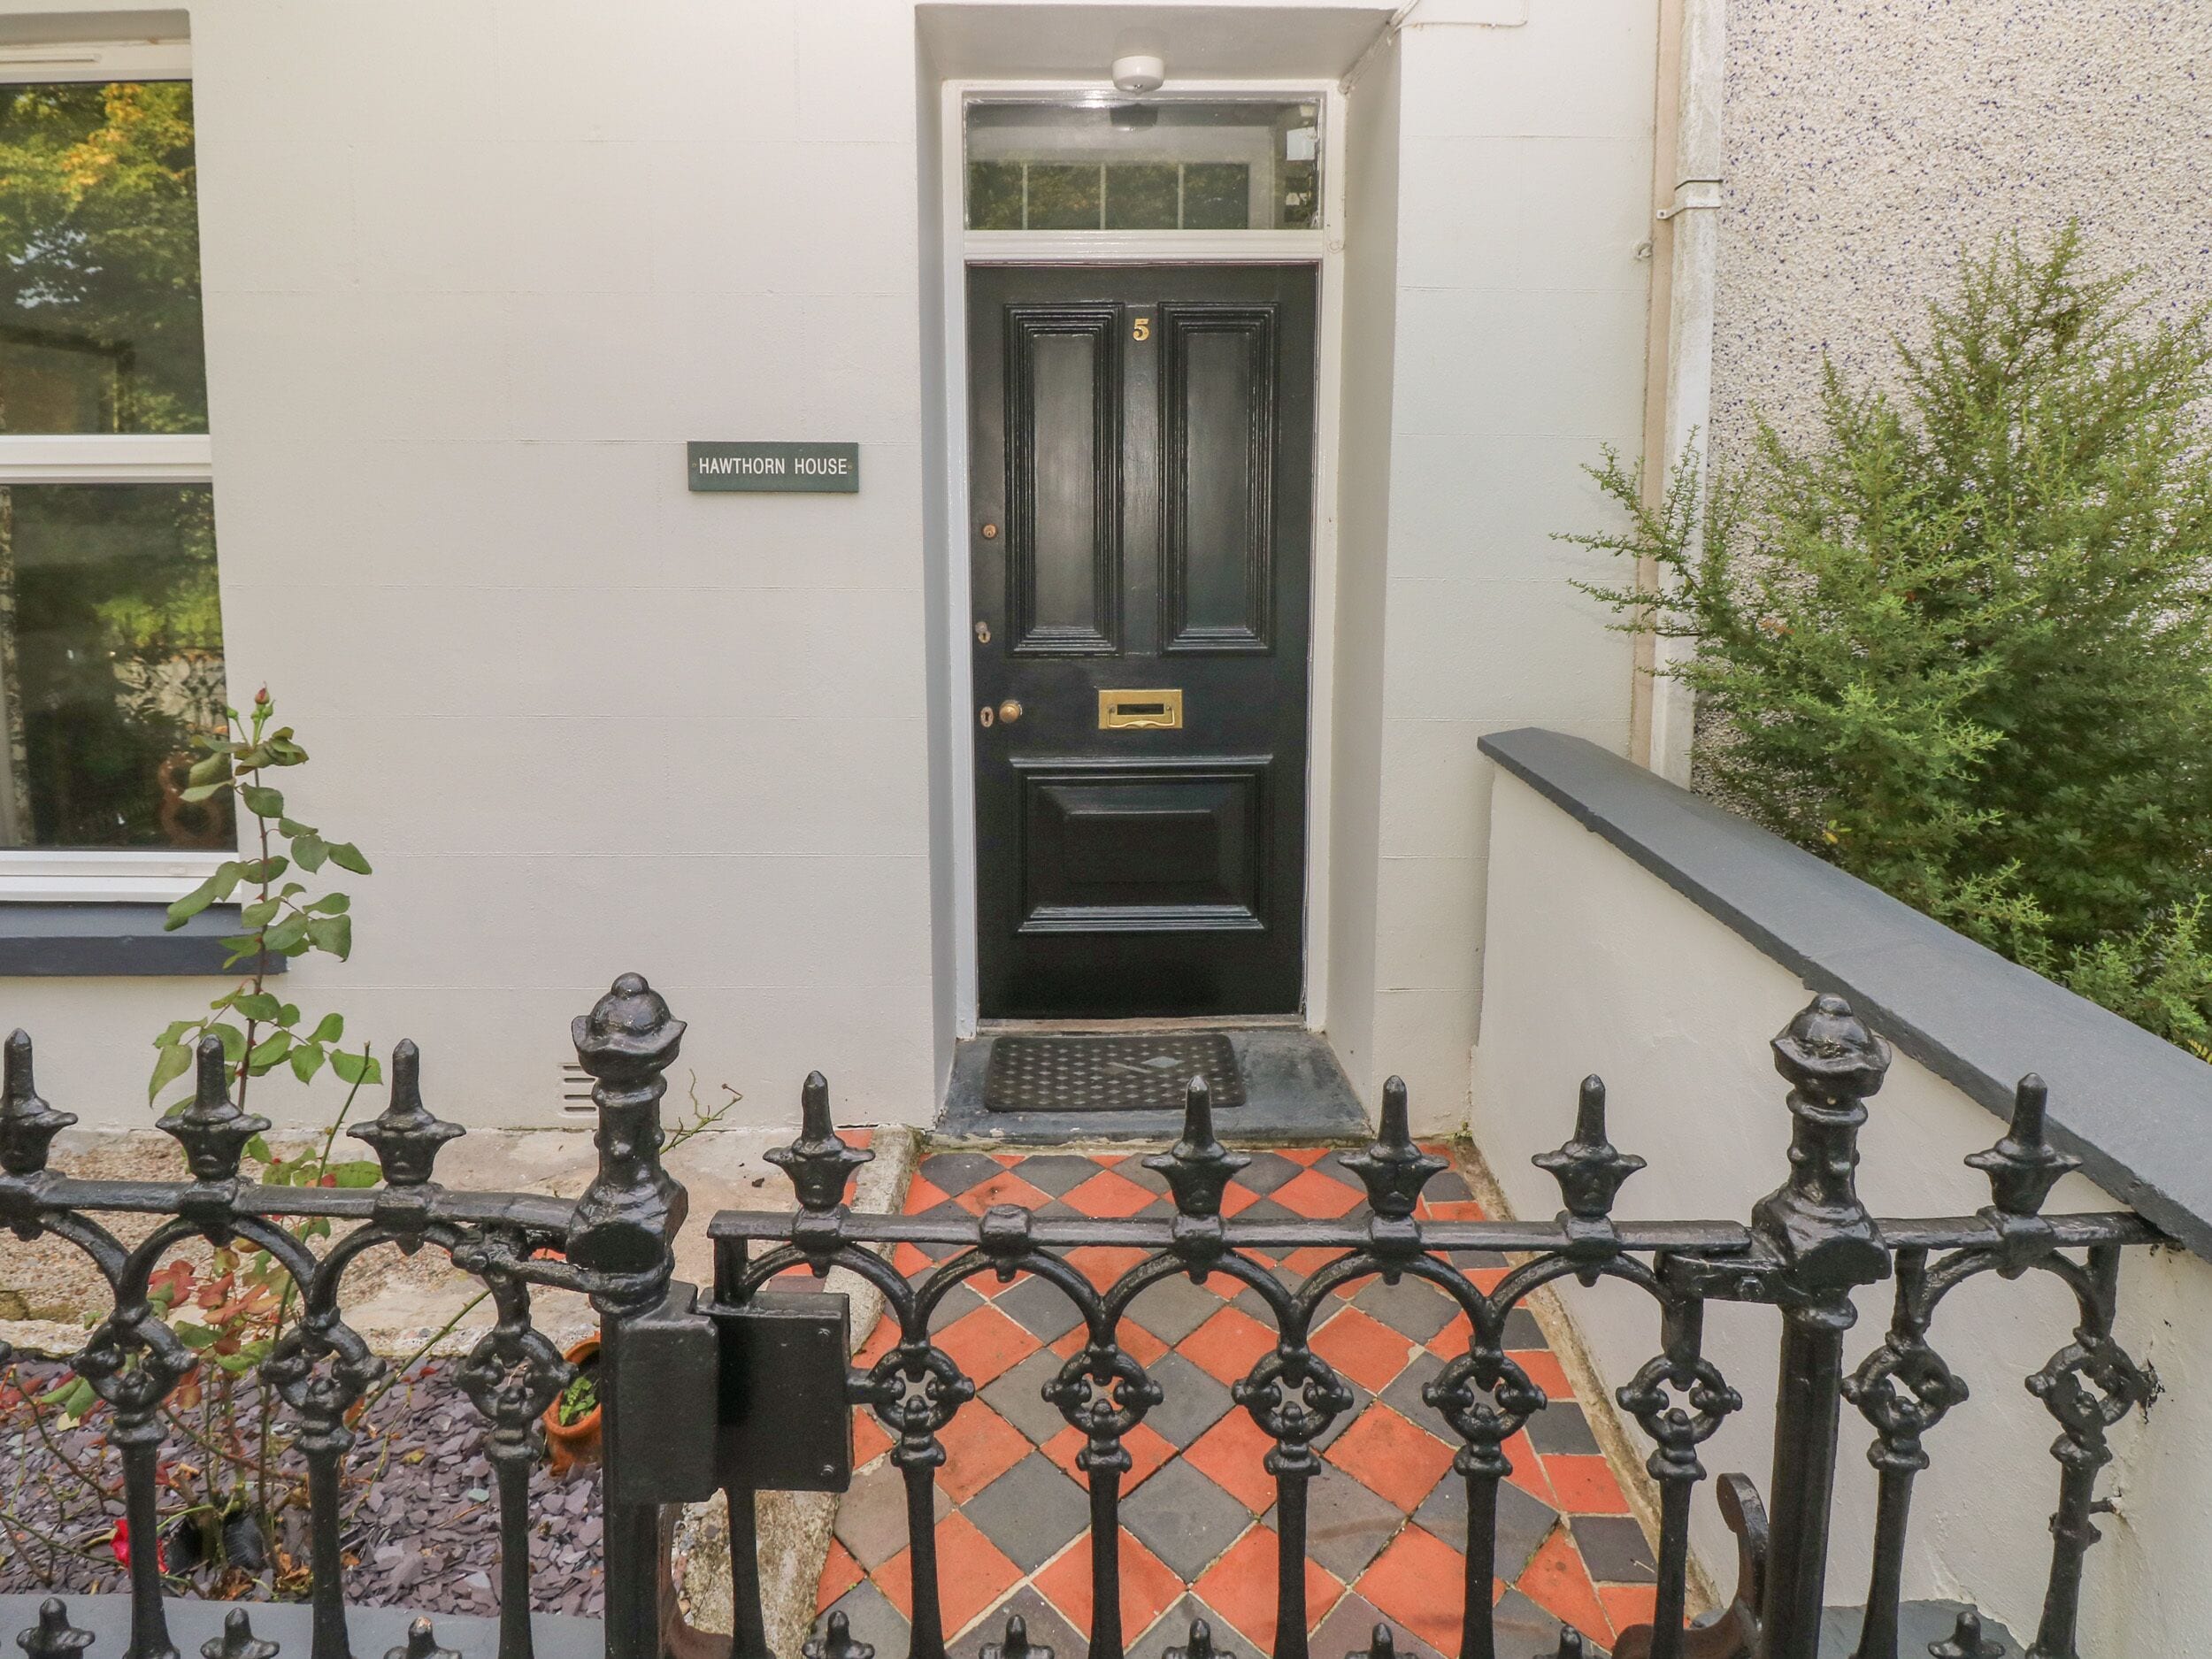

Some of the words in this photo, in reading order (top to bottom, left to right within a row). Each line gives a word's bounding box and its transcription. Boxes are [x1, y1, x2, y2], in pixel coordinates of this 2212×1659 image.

[1133, 318, 1149, 342] 5
[698, 457, 786, 475] HAWTHORN
[795, 457, 848, 475] HOUSE
